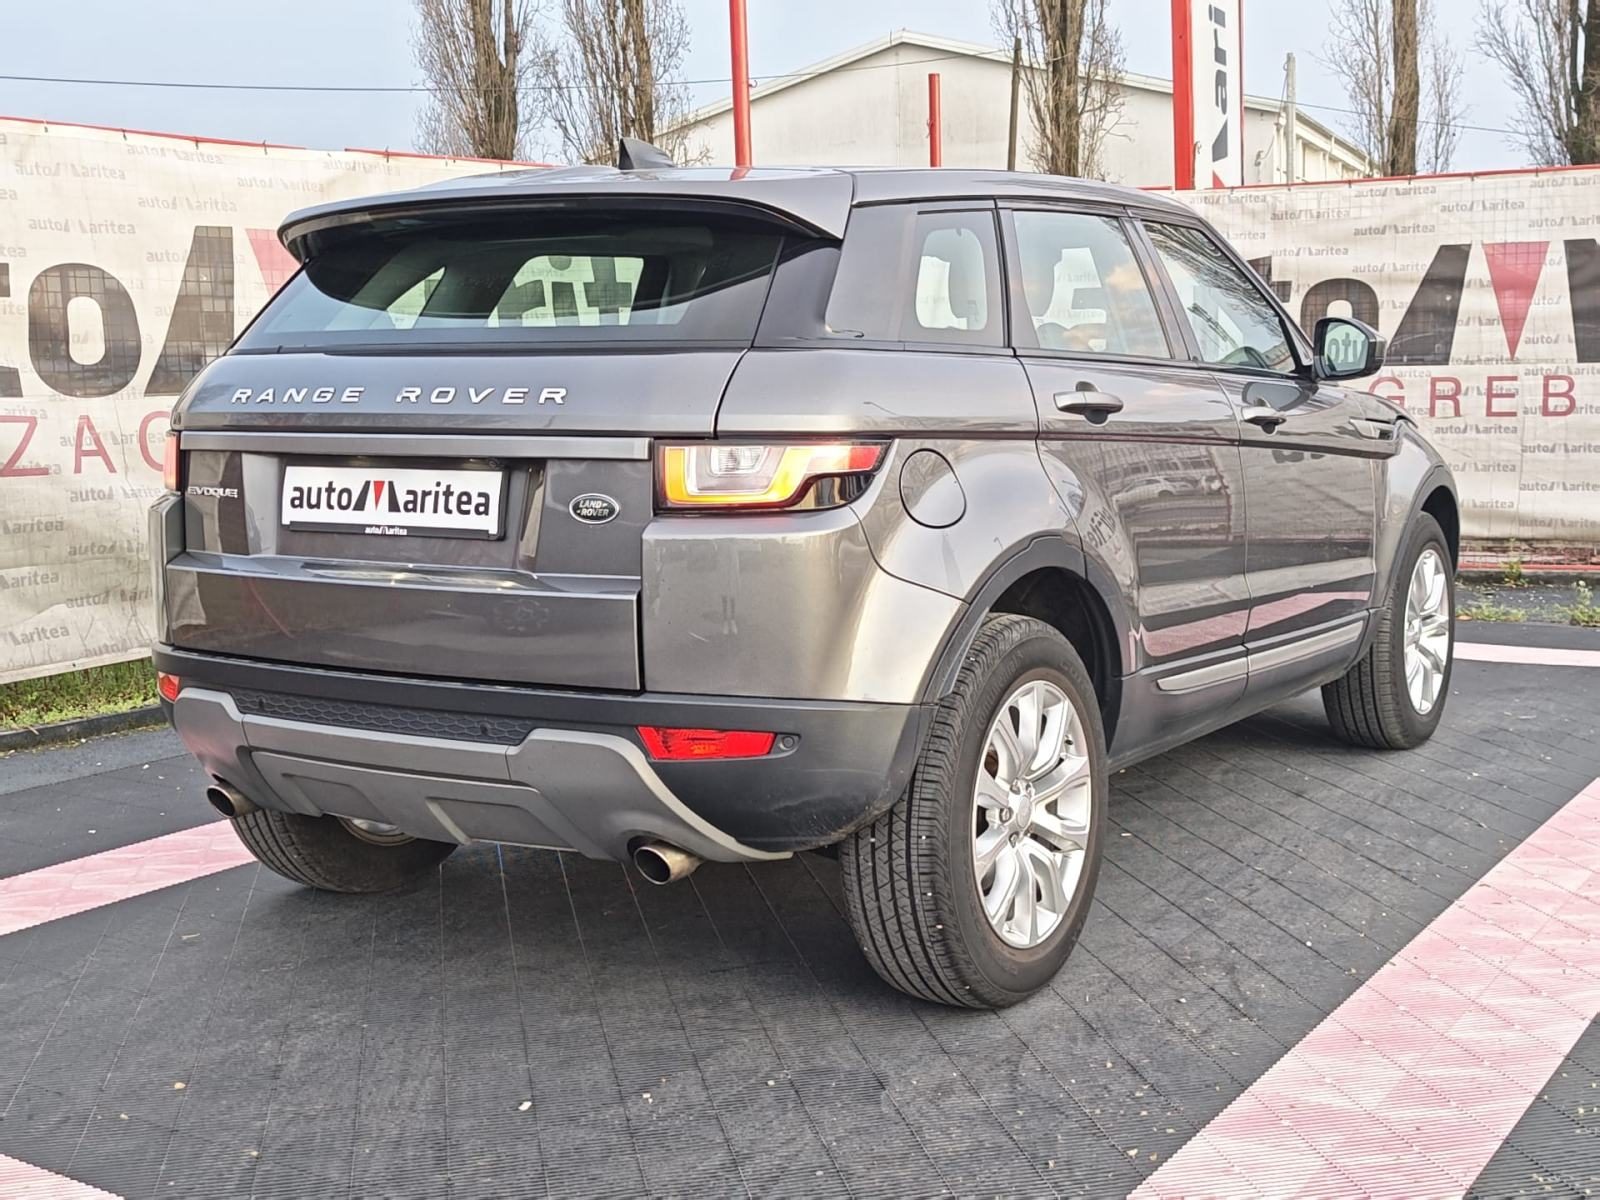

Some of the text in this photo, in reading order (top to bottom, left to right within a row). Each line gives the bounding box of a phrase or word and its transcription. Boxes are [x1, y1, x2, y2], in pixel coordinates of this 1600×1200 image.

[231, 387, 567, 404] RANGE ROVER
[187, 486, 238, 498] EVOQUE
[579, 500, 602, 509] LAND
[580, 508, 609, 517] ROVER
